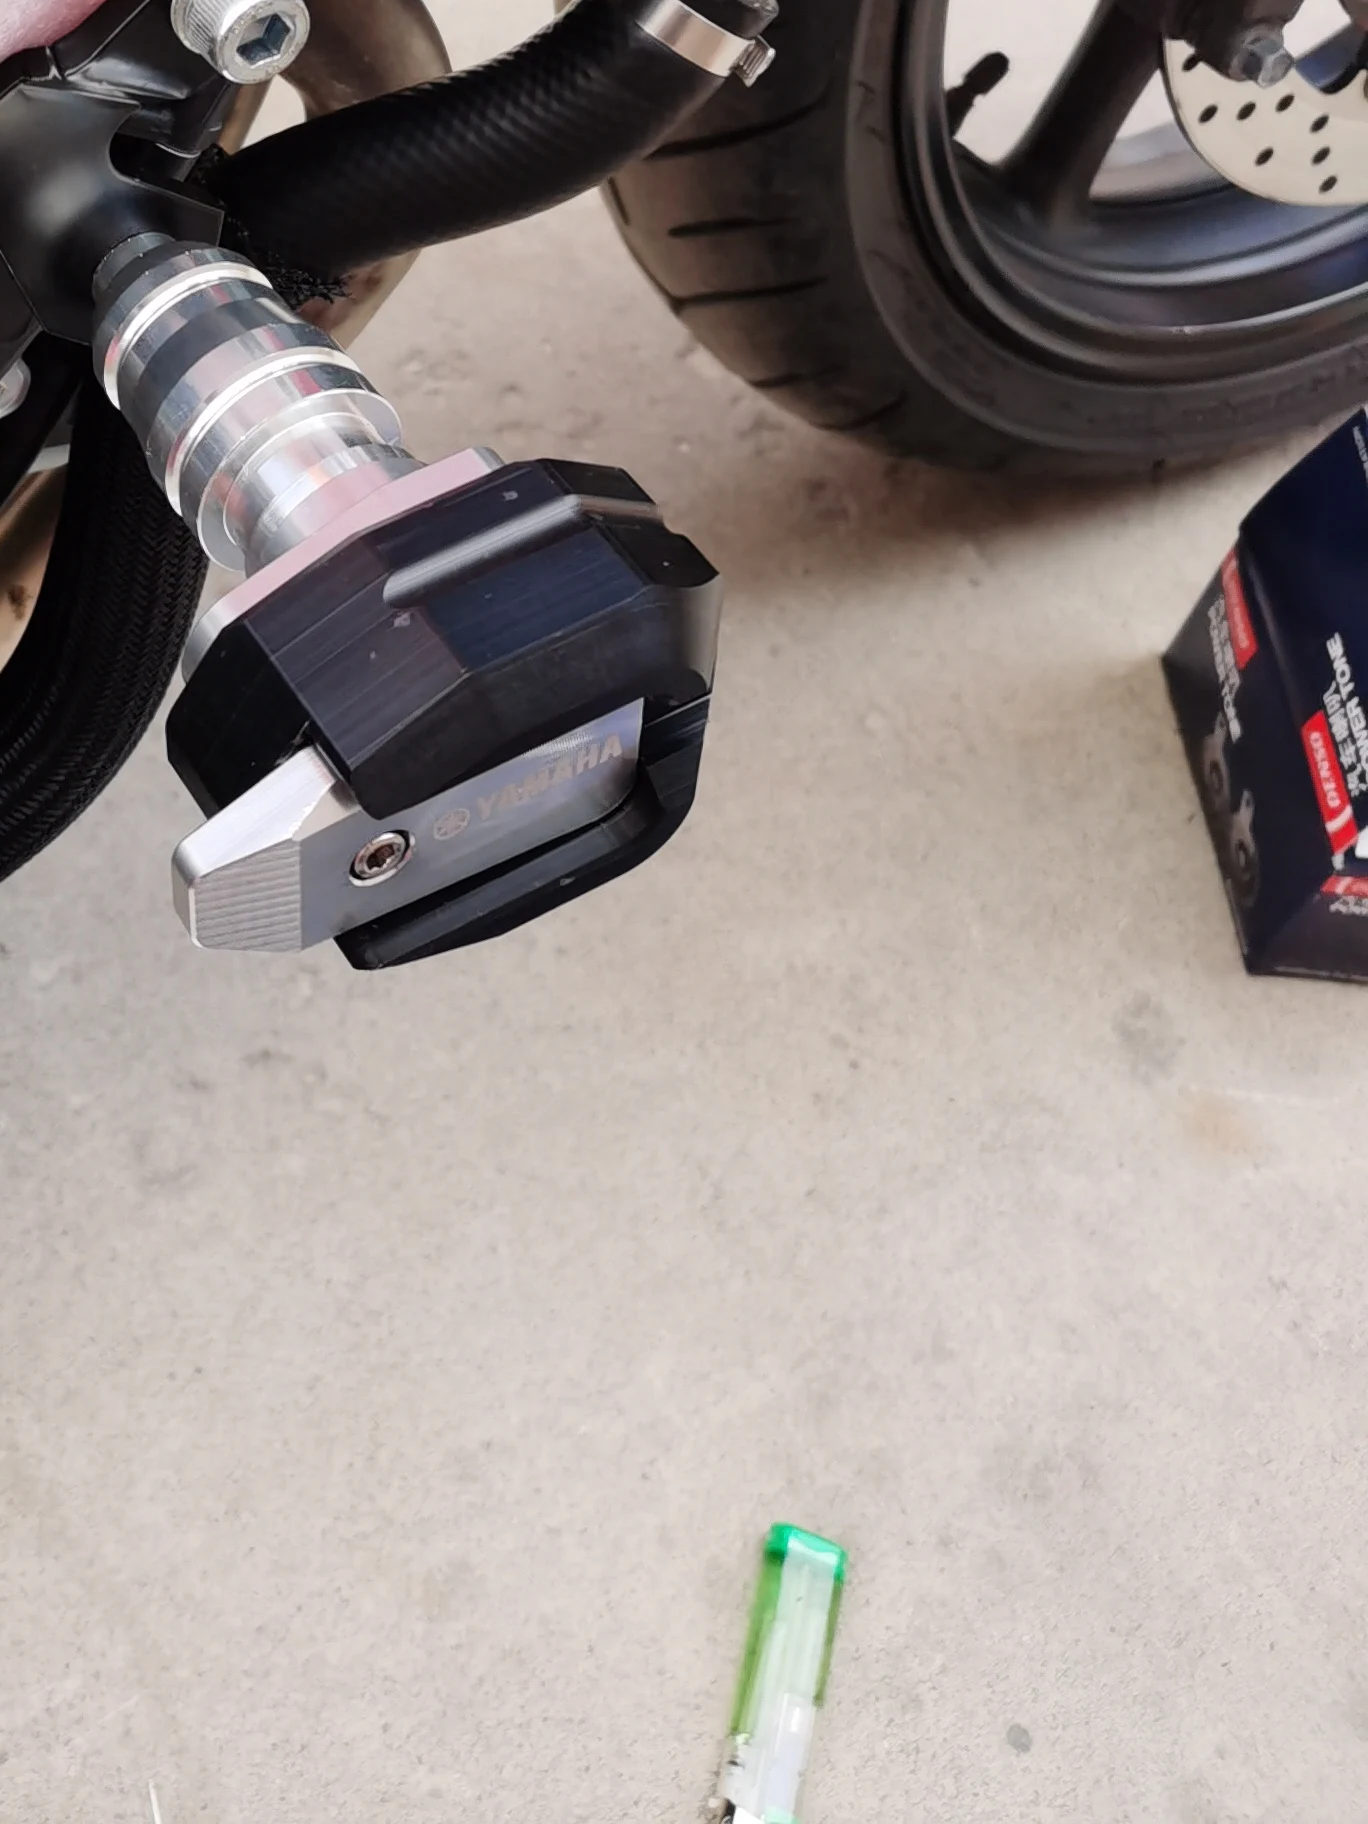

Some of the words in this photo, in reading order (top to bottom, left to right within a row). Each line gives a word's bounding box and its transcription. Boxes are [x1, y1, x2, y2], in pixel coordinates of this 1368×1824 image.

[1326, 632, 1355, 701] TONE
[477, 733, 623, 820] YAMAHA
[1309, 731, 1341, 809] DENSO
